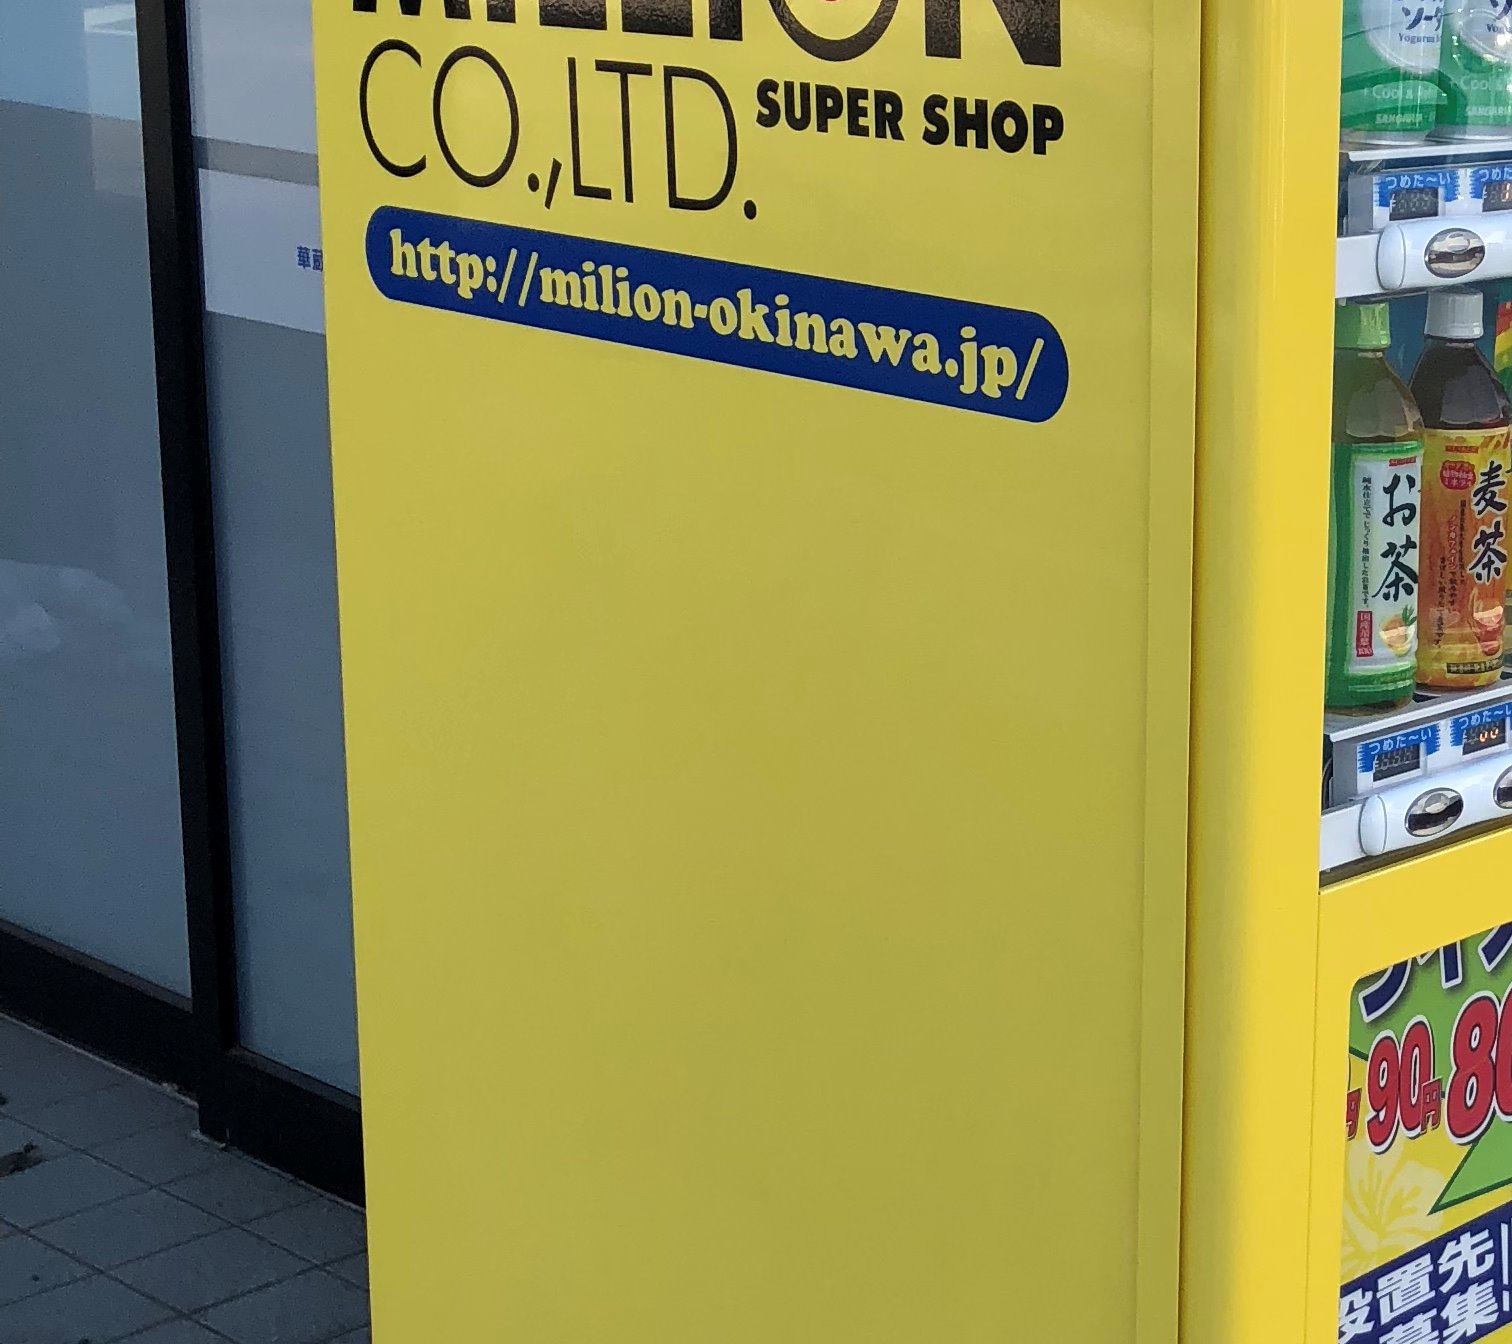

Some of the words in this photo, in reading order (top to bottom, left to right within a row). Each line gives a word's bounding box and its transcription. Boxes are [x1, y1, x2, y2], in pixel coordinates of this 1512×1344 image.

[358, 38, 758, 220] CO.,LTD.
[755, 78, 905, 142] SUPER
[921, 92, 1065, 156] SHOP
[389, 228, 1045, 402] http://milion-okinawa.jp/
[1371, 472, 1421, 603] お茶
[1468, 460, 1508, 585] 麦茶
[1366, 1014, 1443, 1154] 90円
